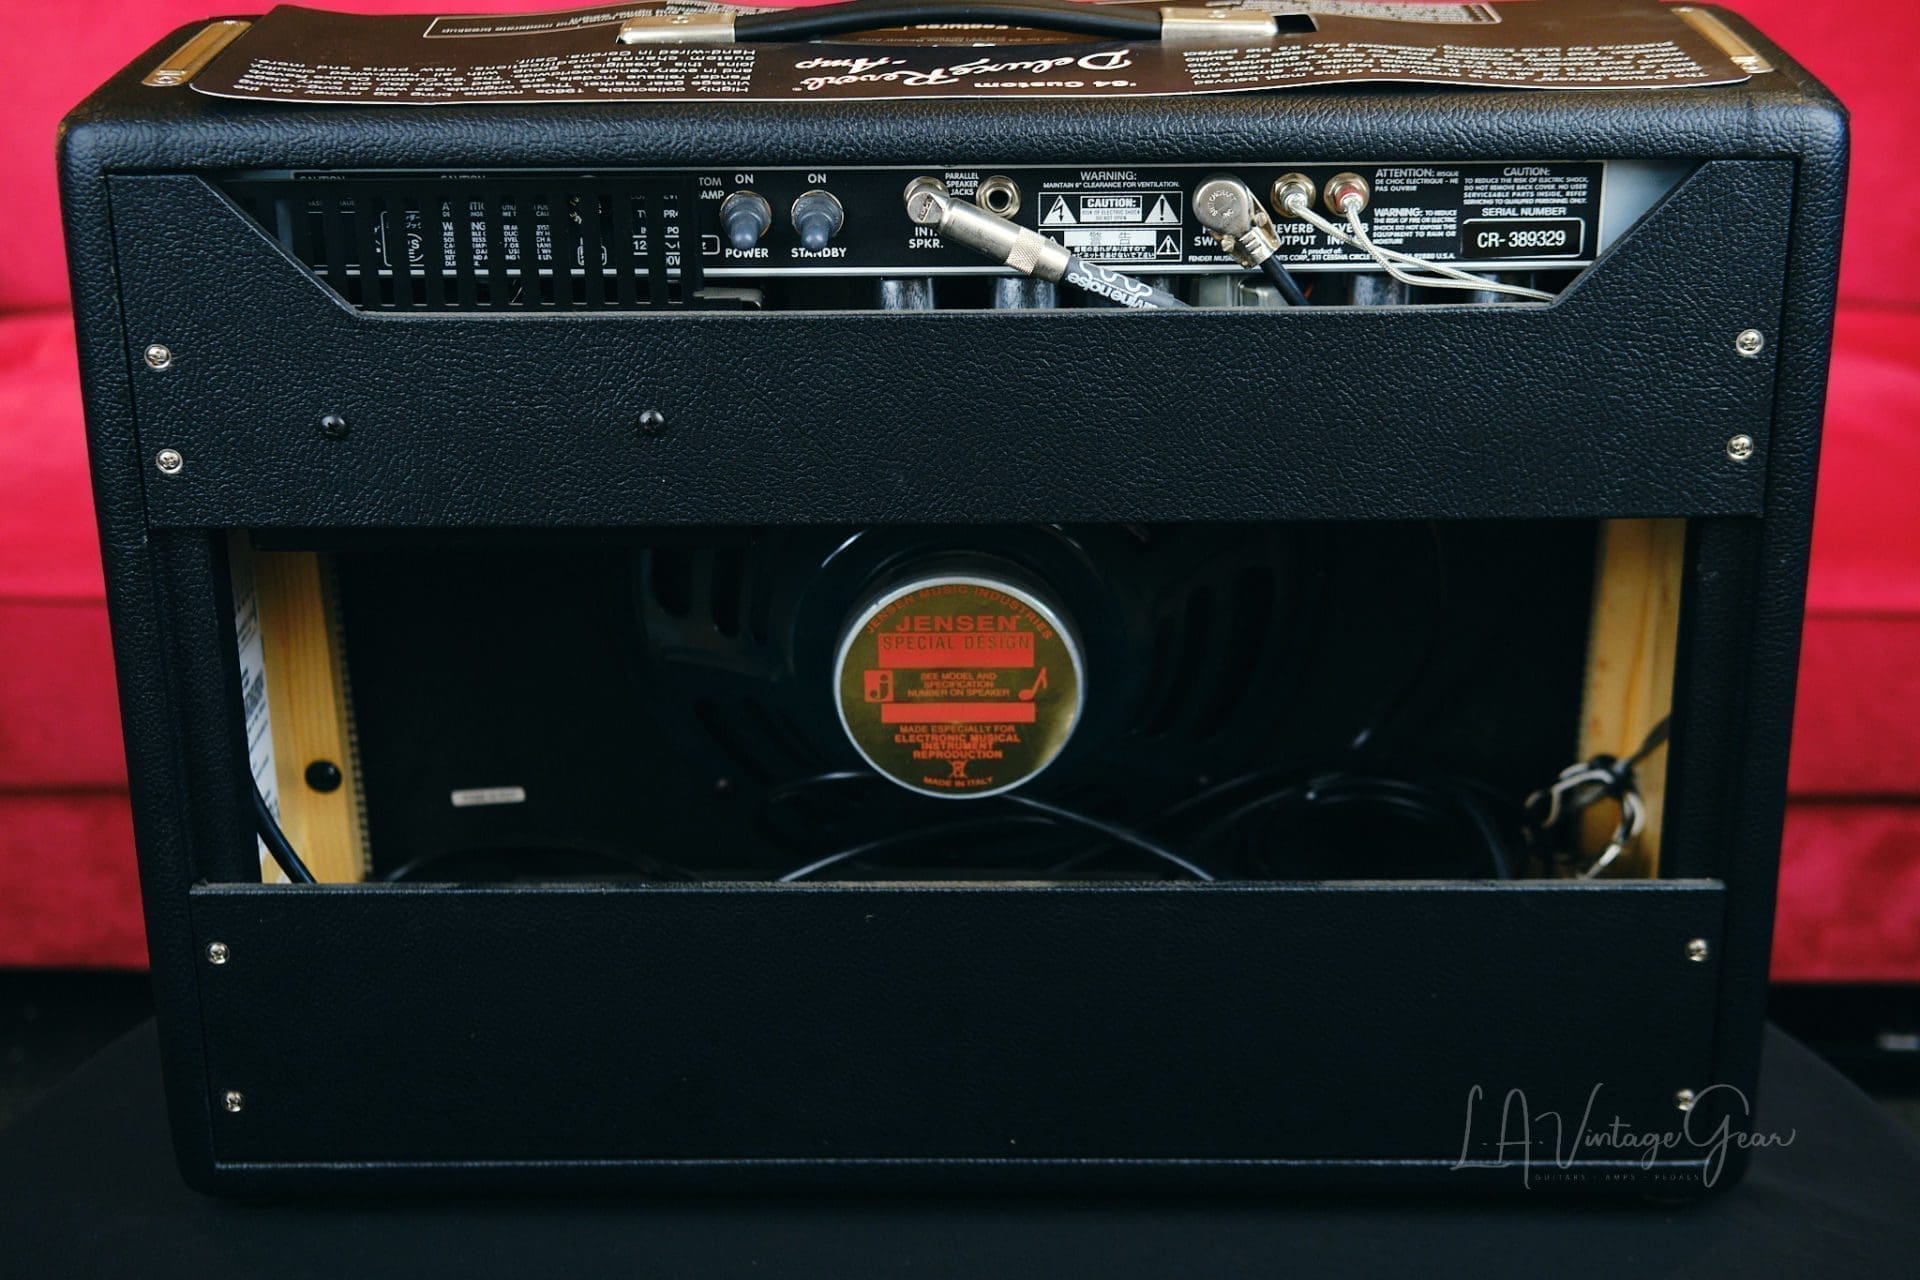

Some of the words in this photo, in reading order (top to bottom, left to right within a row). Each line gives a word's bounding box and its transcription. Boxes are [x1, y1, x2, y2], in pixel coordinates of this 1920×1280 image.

[949, 50, 1132, 76] Deluxe
[799, 68, 959, 91] Reverb
[945, 172, 979, 180] PARALLEL
[1080, 171, 1137, 180] WARNING:
[1375, 168, 1435, 177] ATTENTION:
[1503, 167, 1550, 176] CAUTION:
[735, 174, 754, 184] ON
[807, 173, 827, 184] ON
[946, 180, 979, 188] SPEAKER
[700, 190, 724, 199] AMP
[950, 188, 974, 196] JACKS
[1087, 198, 1137, 208] CAUTION:
[1373, 207, 1423, 216] WARNING:
[1481, 207, 1519, 216] SERIAL
[1520, 207, 1567, 216] NUMBER
[1274, 223, 1314, 233] EVERB
[908, 238, 944, 249] SPKR.
[1280, 235, 1317, 245] UTPUT
[725, 248, 769, 258] POWER
[866, 596, 915, 634] JENSEN
[919, 584, 969, 598] MUSIC
[974, 587, 1053, 640] INDUSTRIES
[896, 615, 1018, 632] JENSEN
[882, 634, 953, 650] SPECIAL
[964, 634, 1030, 650] DESIGN
[943, 672, 975, 681] MODEL
[977, 672, 997, 681] AND
[923, 680, 994, 689] SPECIFICATION
[907, 689, 948, 698] NUMBER
[949, 689, 964, 698] ON
[966, 689, 1010, 698] SPEAKER
[899, 725, 929, 733] MADE
[931, 725, 991, 733] ESPECIALLY
[993, 725, 1015, 733] FOR
[894, 734, 968, 743] ELECTRONIC
[970, 734, 1021, 743] MUSICAL
[921, 742, 994, 750] INSTRUMENT
[913, 750, 1003, 759] REPRODUCTION
[923, 776, 952, 787] MADE
[954, 779, 965, 787] IN
[967, 776, 993, 787] ITALY
